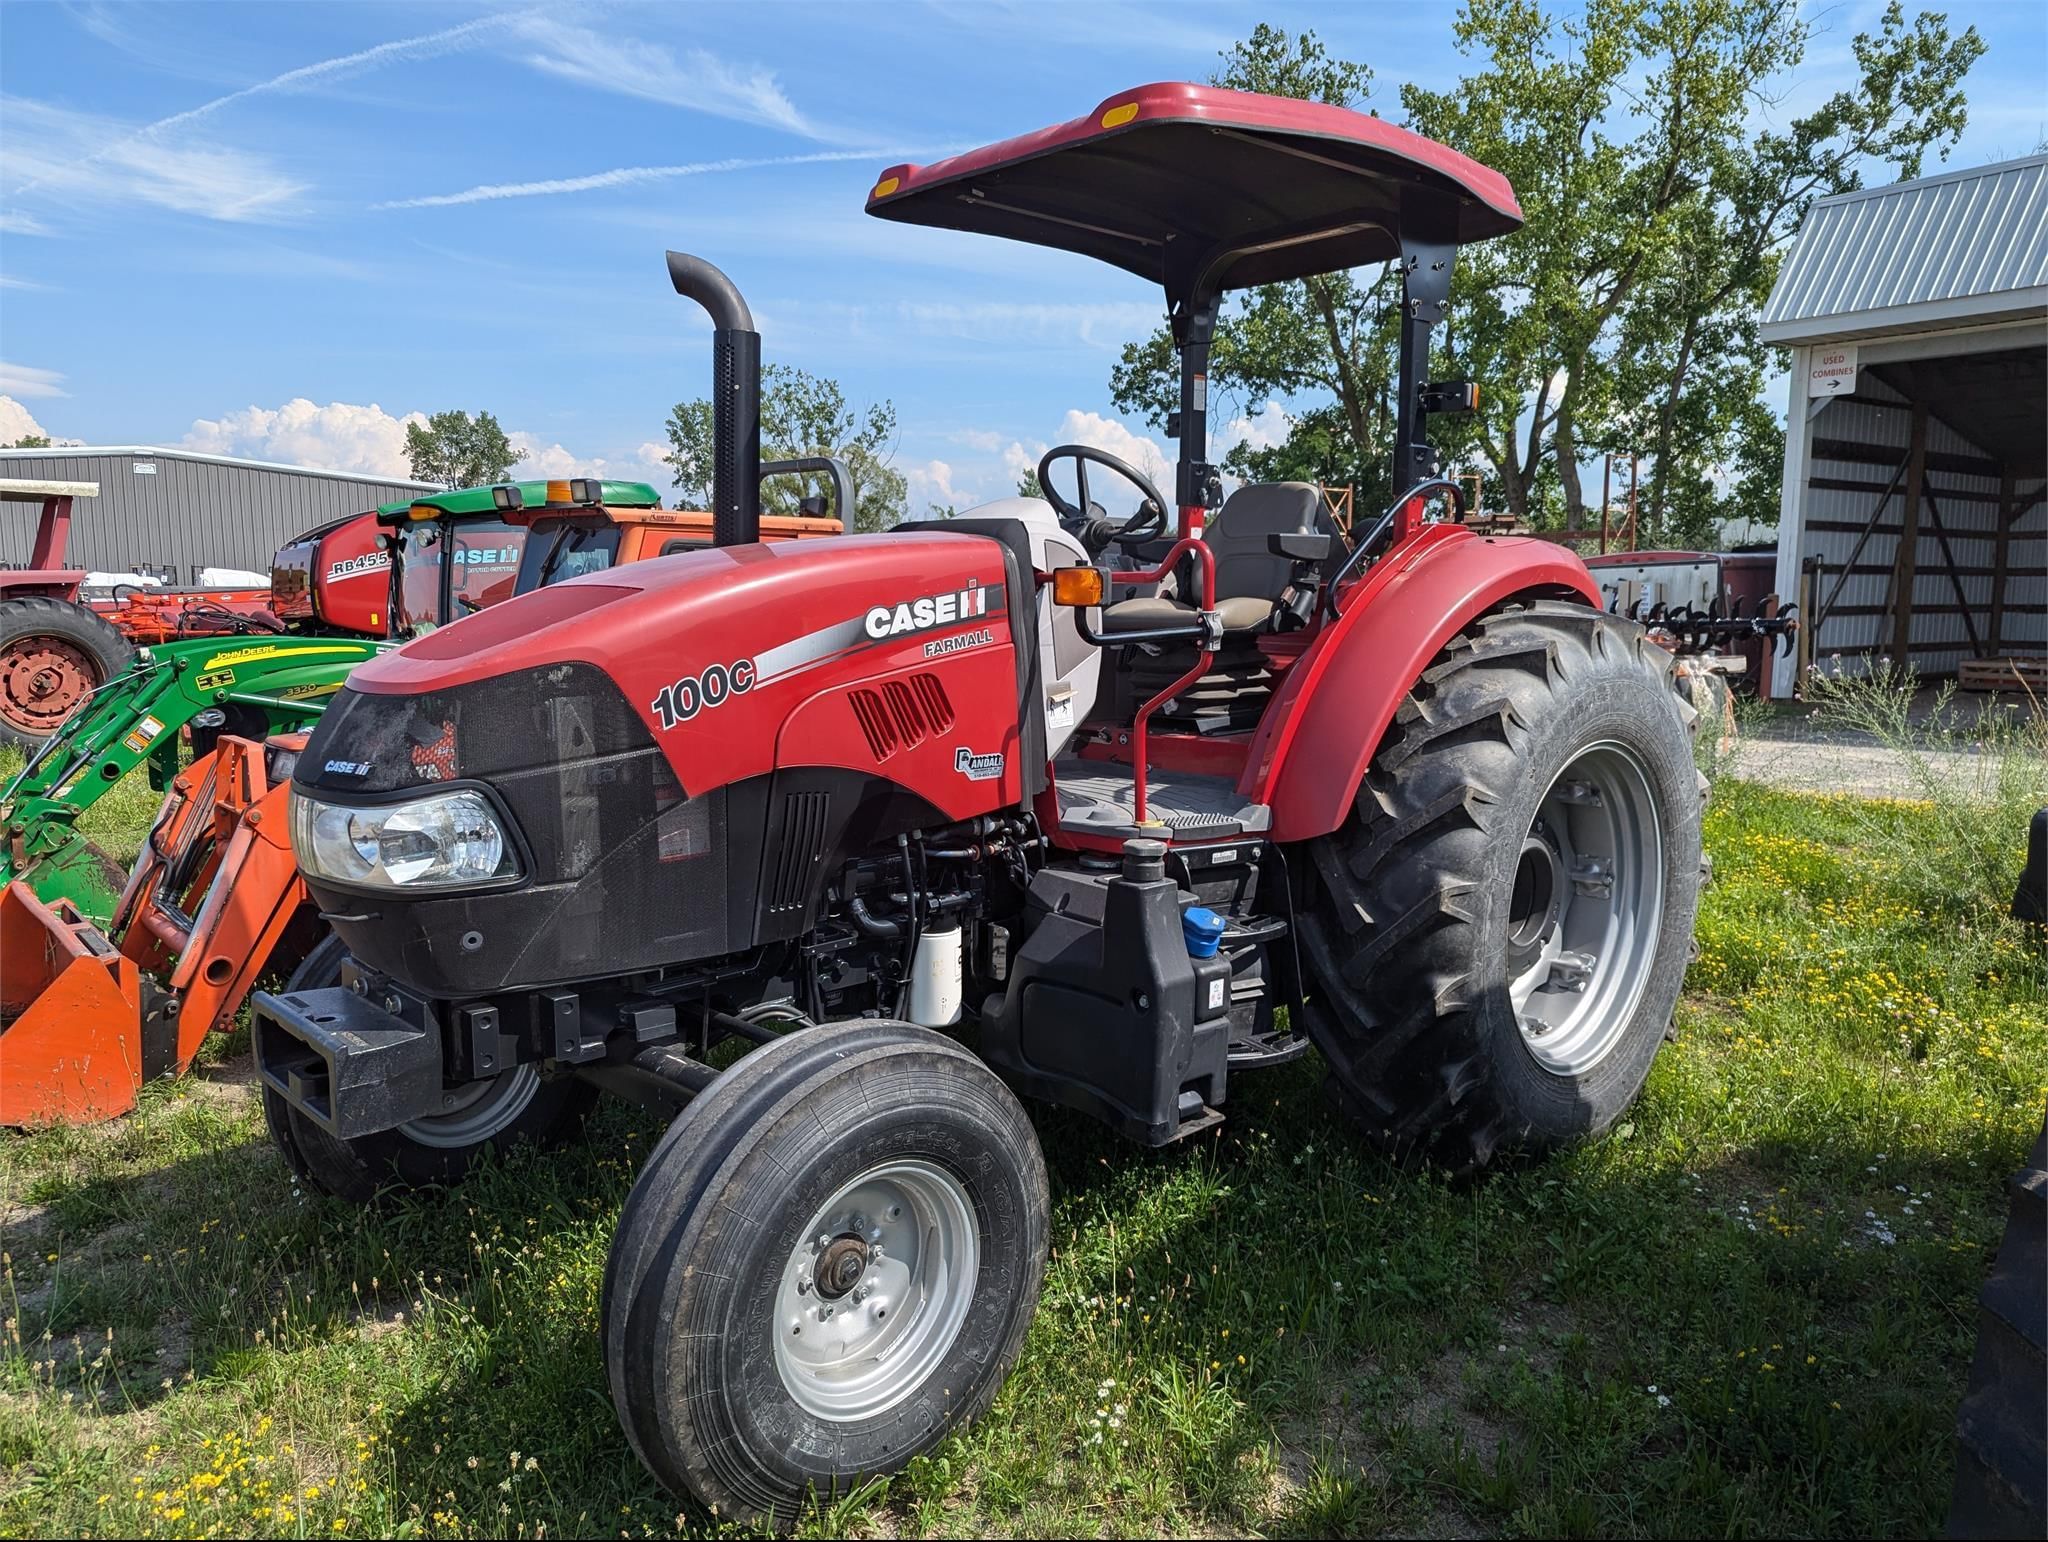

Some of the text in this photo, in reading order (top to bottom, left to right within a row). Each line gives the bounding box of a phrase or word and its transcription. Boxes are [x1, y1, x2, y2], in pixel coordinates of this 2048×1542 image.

[1823, 355, 1845, 365] USED
[1812, 367, 1854, 378] COMBINES
[333, 553, 389, 575] RB455
[865, 594, 956, 639] CASE
[923, 629, 994, 658] FARMALL
[214, 645, 276, 661] JOHN DEERE
[286, 683, 317, 697] 3320
[325, 760, 355, 773] CASE
